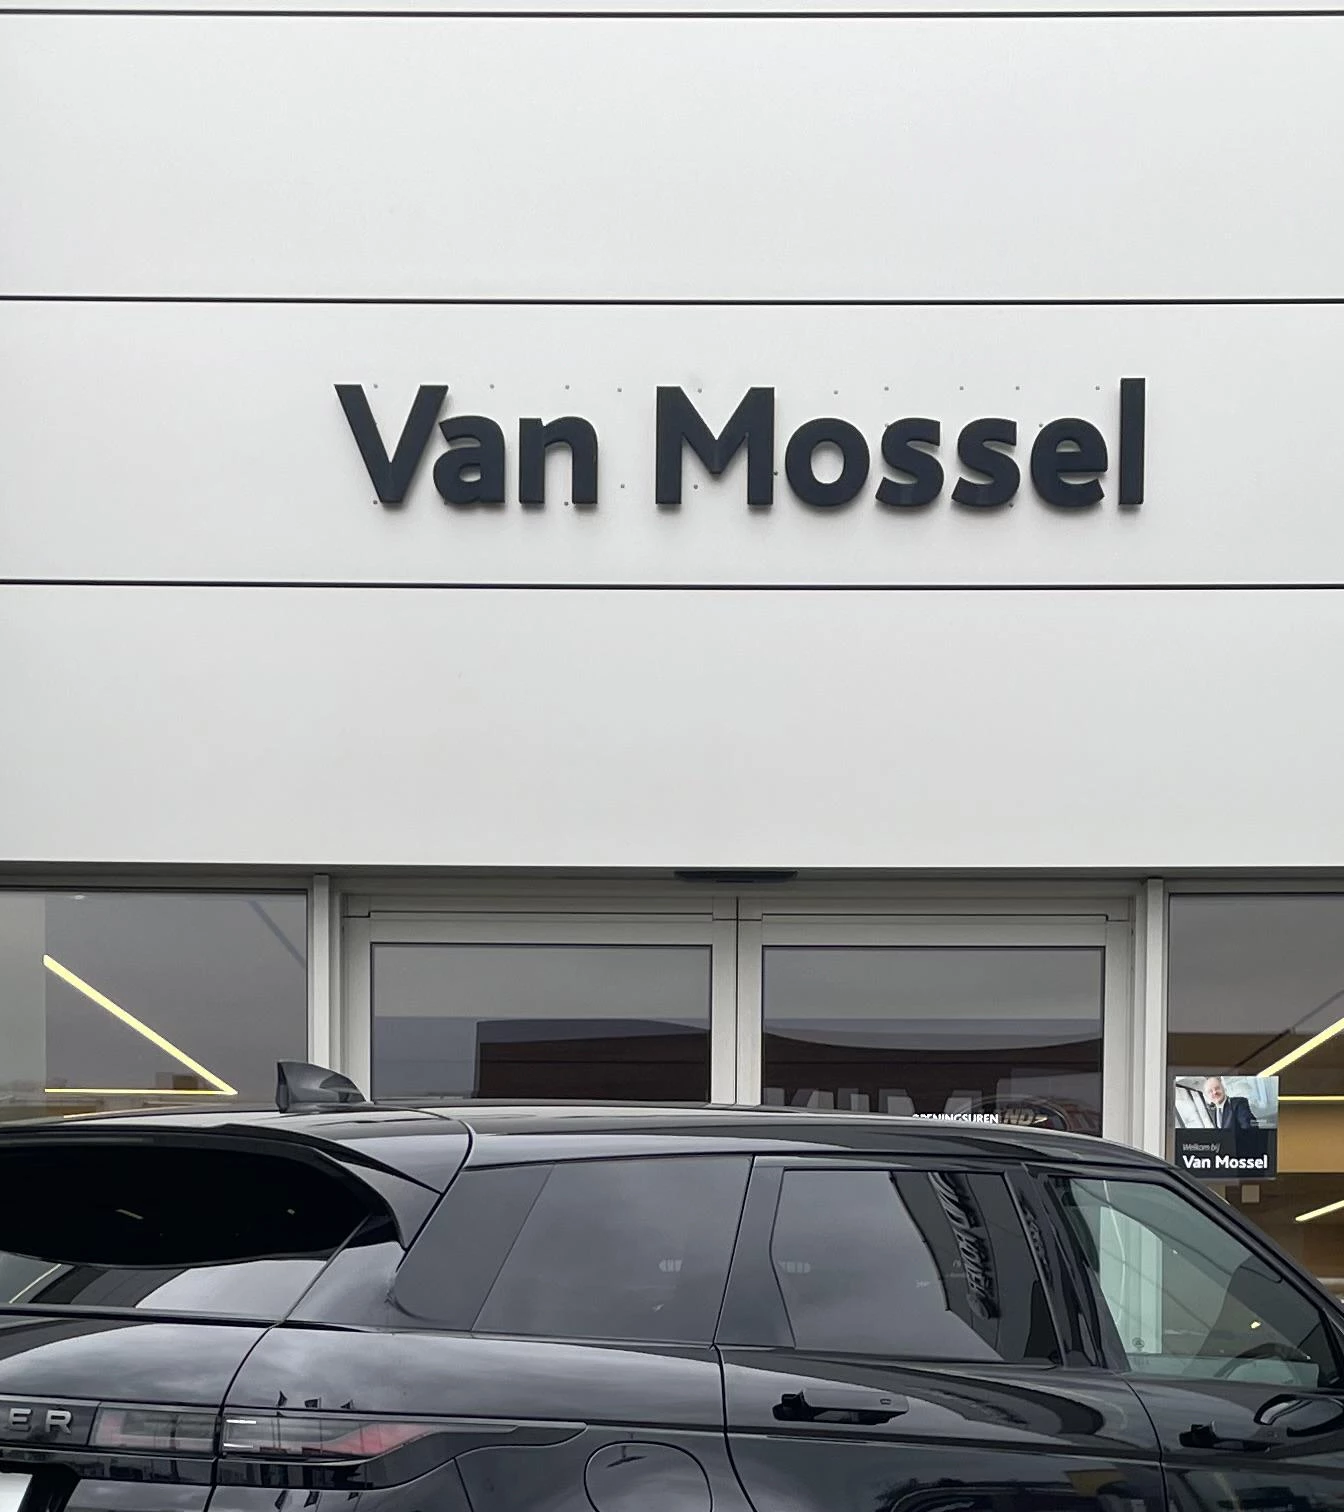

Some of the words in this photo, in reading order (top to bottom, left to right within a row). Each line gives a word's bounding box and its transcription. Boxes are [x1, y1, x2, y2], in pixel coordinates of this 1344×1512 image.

[333, 383, 599, 507] Van
[654, 377, 1147, 510] Mossel
[1182, 1154, 1211, 1169] Van
[1215, 1154, 1268, 1169] Mossel
